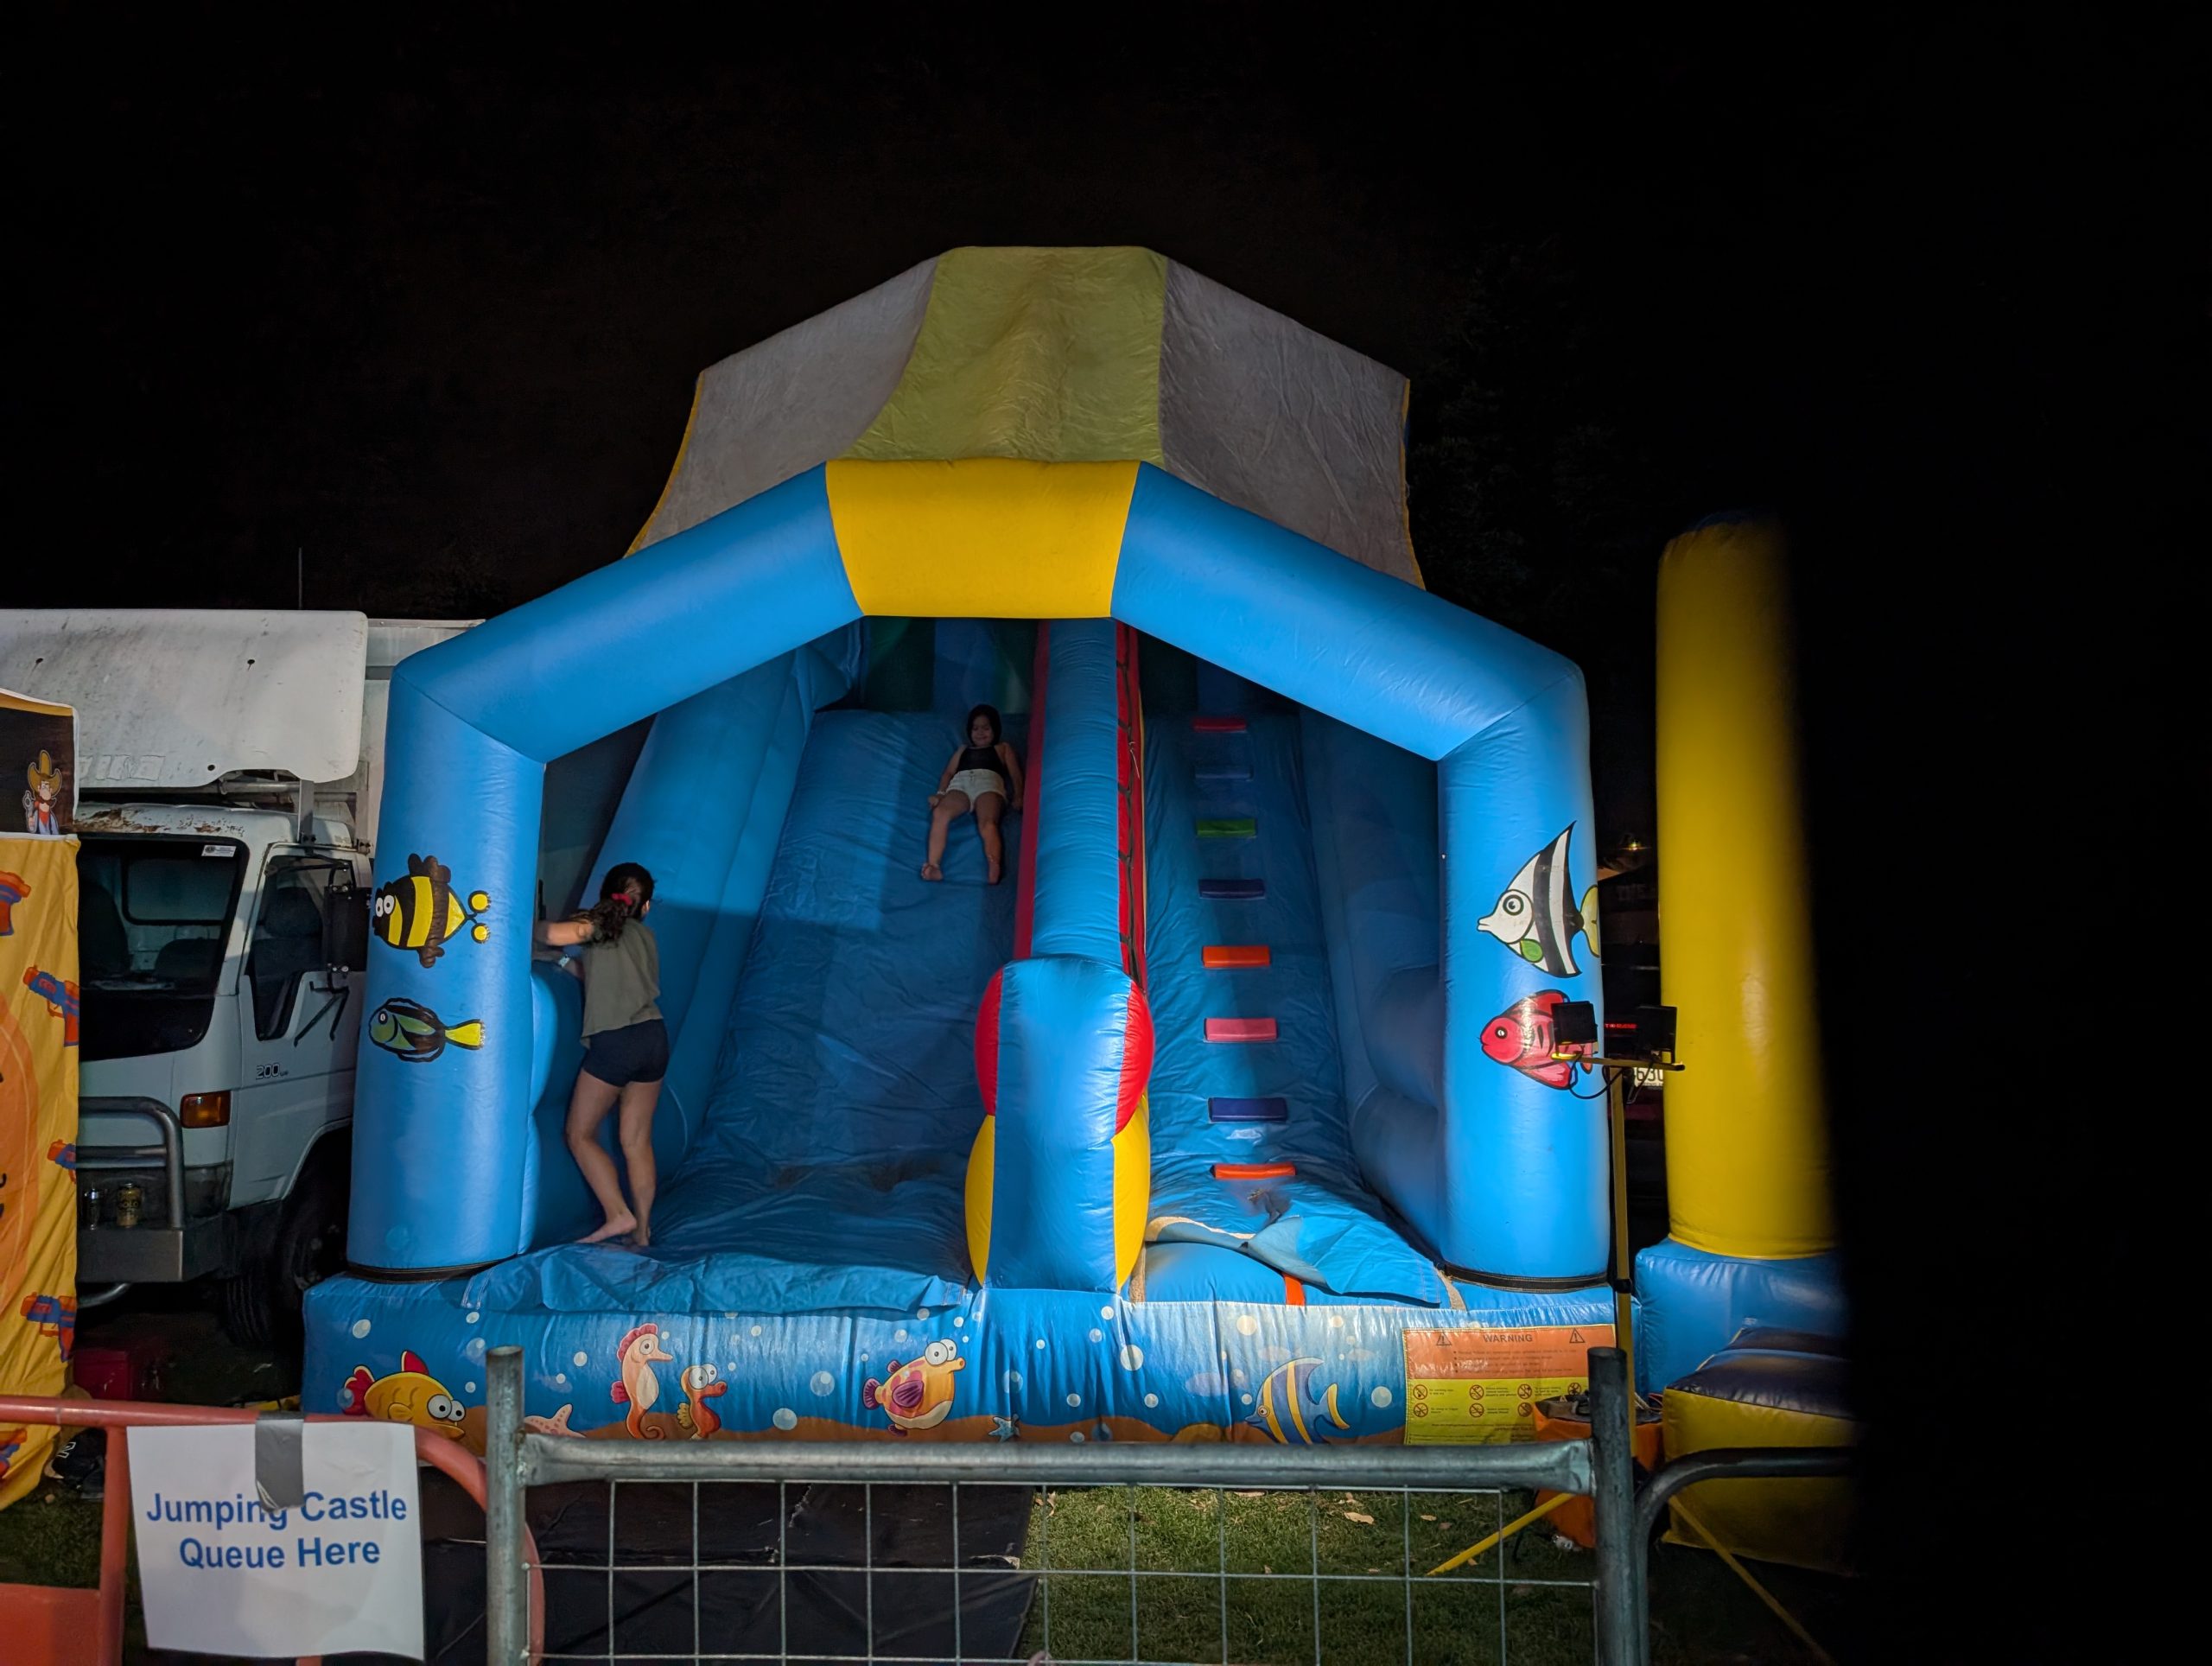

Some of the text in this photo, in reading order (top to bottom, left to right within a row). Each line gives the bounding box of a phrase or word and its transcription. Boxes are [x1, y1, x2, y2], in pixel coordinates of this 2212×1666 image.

[256, 1062, 280, 1080] 200
[1483, 1333, 1533, 1343] WARNING
[301, 1490, 407, 1522] Castle
[180, 1536, 380, 1569] Queue Here
